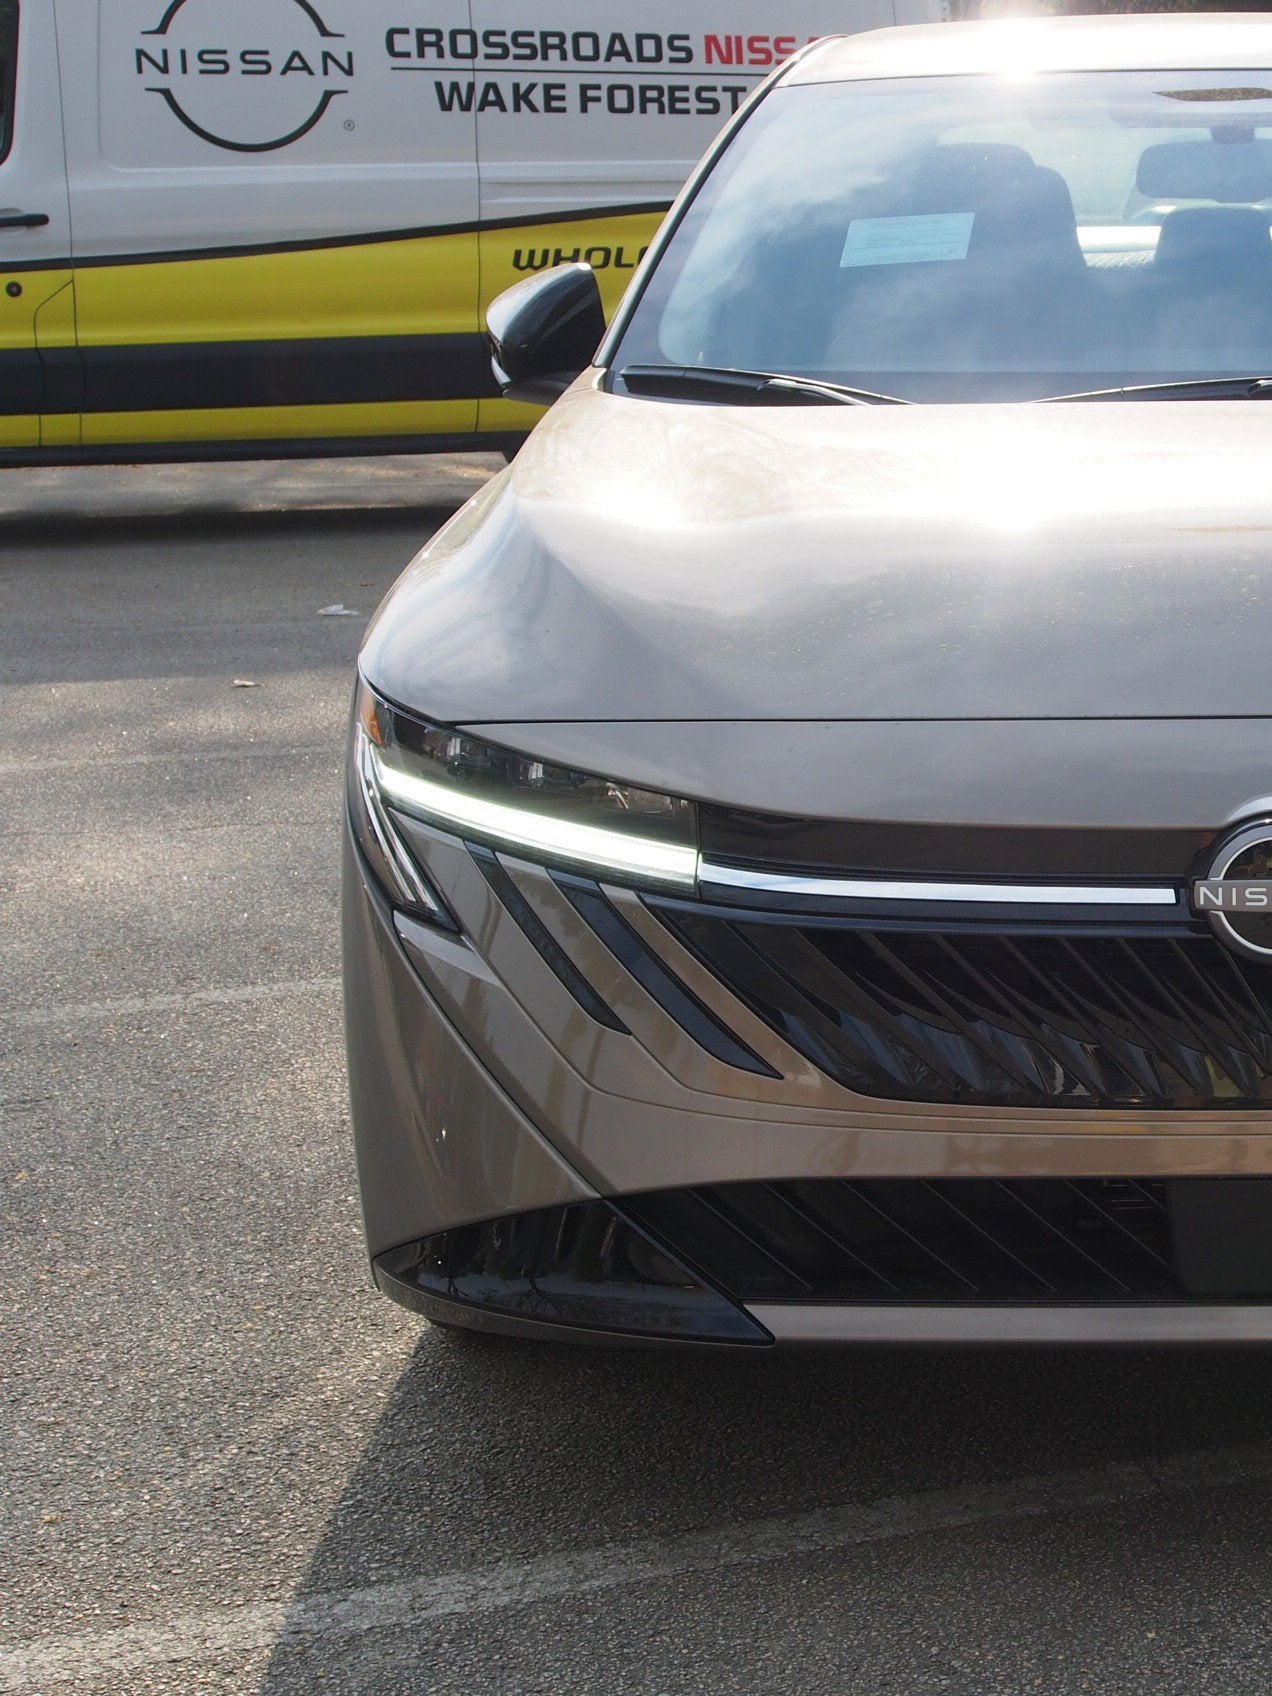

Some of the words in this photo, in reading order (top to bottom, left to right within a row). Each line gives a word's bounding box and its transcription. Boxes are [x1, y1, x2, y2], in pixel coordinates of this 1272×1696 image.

[386, 27, 694, 64] CROSSROADS
[135, 48, 354, 76] NISSAN
[434, 81, 567, 113] WAKE
[579, 83, 748, 116] FOREST
[512, 246, 650, 271] WHOL
